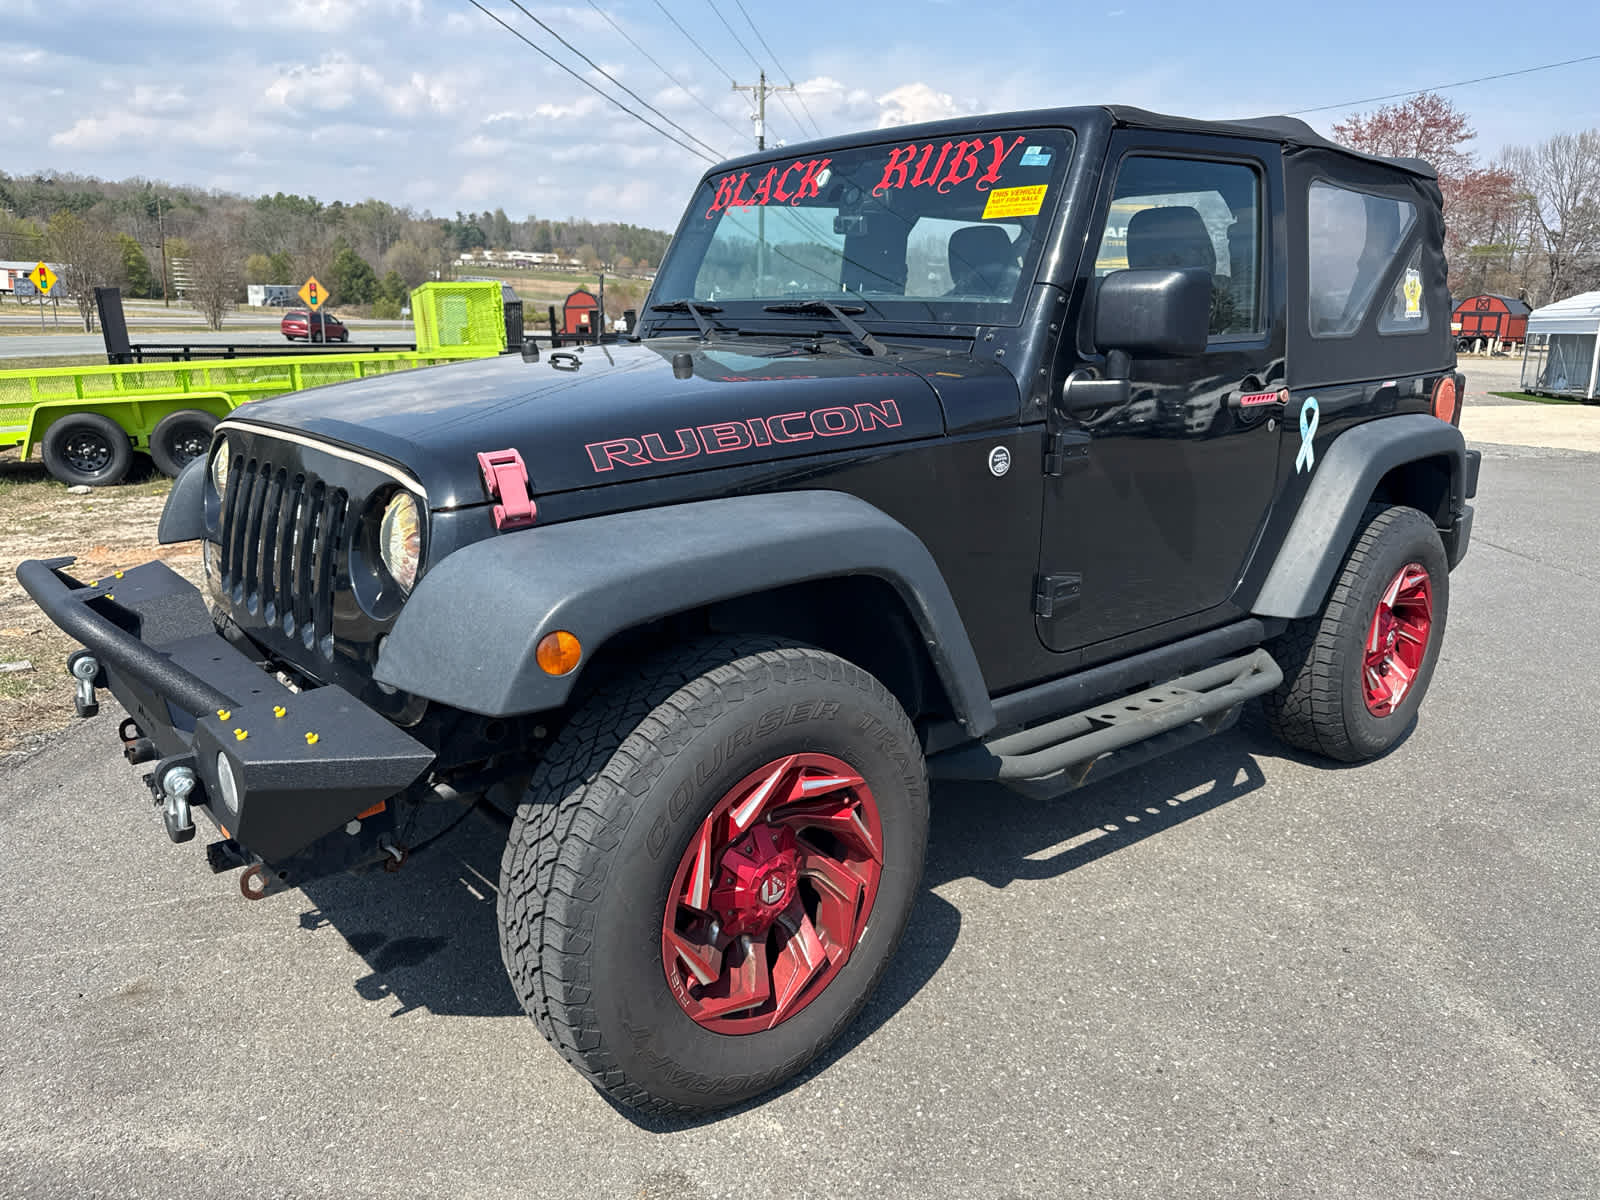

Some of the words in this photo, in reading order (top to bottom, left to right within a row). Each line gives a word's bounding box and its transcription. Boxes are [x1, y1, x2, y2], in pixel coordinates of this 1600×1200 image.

[705, 159, 832, 220] BLACK
[872, 136, 1025, 197] RUBY
[585, 400, 902, 472] RUBICON
[646, 698, 841, 860] COURSER
[670, 961, 691, 1008] FUEL
